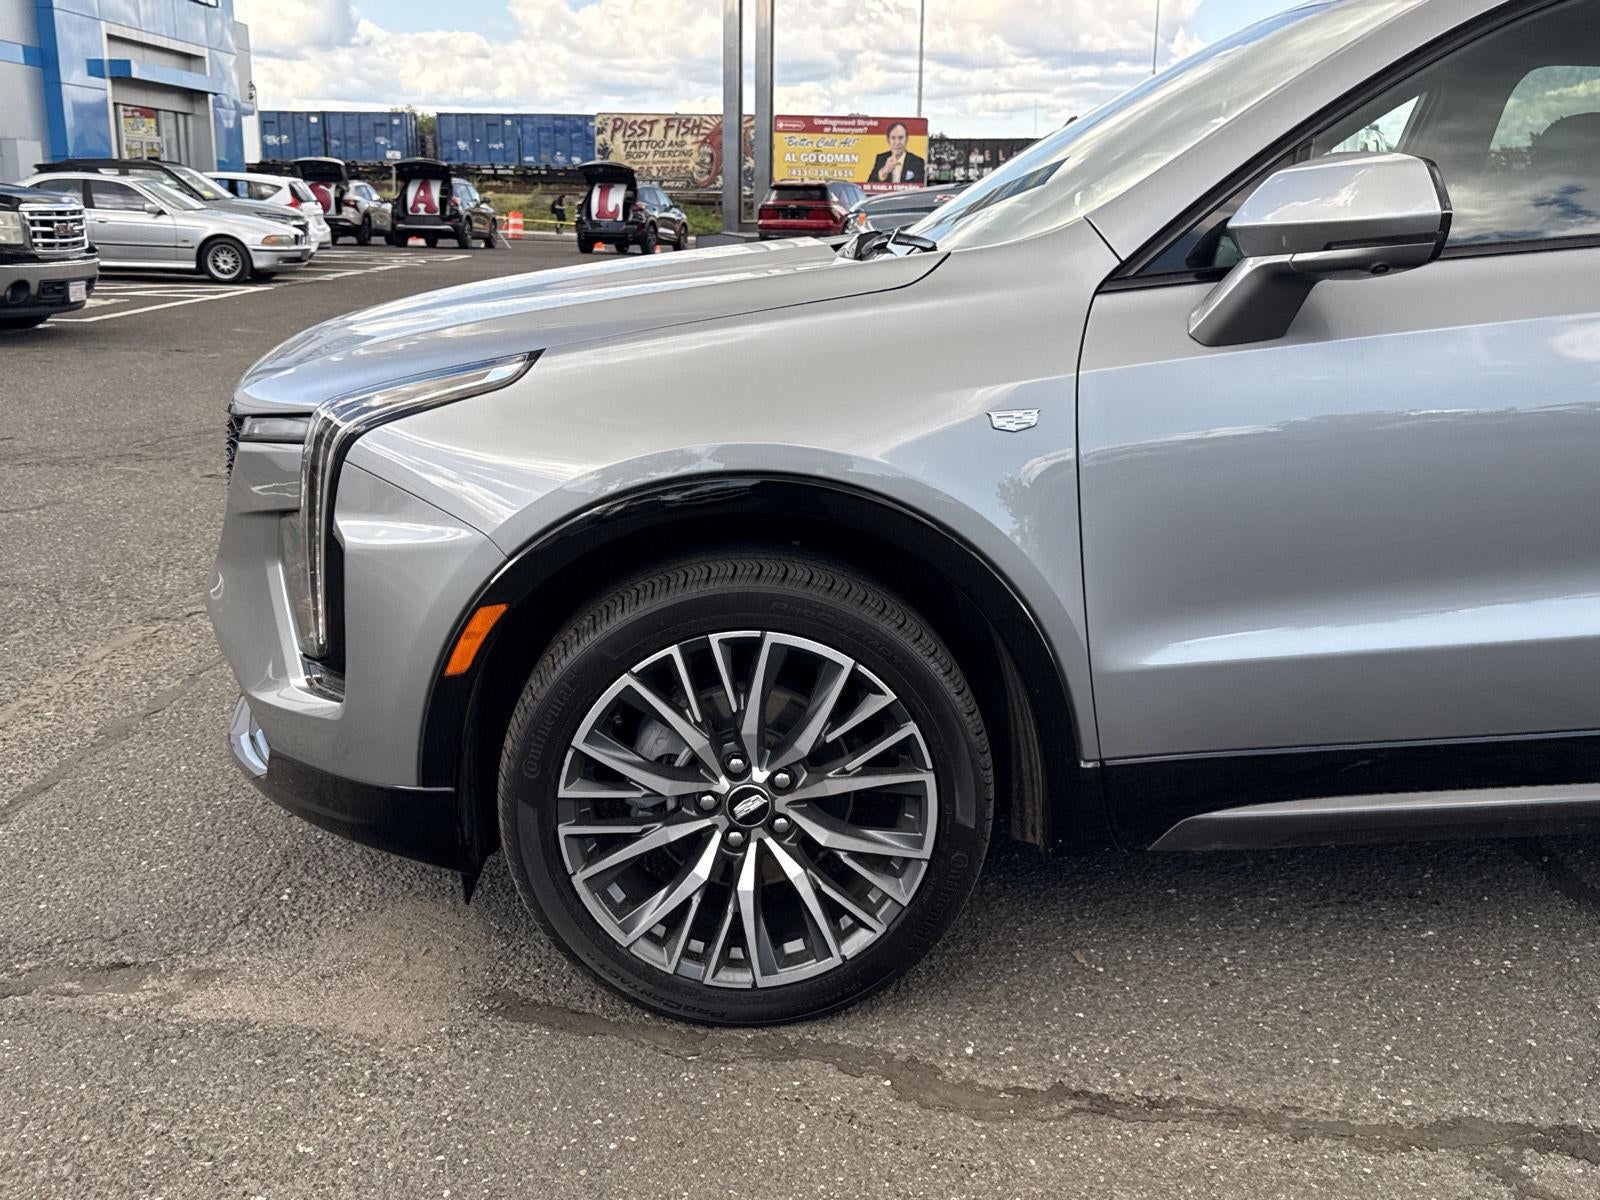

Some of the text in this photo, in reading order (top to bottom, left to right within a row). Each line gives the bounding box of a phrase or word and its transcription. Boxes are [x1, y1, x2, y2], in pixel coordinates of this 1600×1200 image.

[610, 117, 701, 141] PISST FISH
[623, 140, 687, 152] TATTOO AND
[816, 137, 838, 148] Call
[625, 149, 693, 160] BODY PIERCING
[784, 153, 797, 163] AL
[410, 178, 439, 214] A
[596, 183, 620, 220] L
